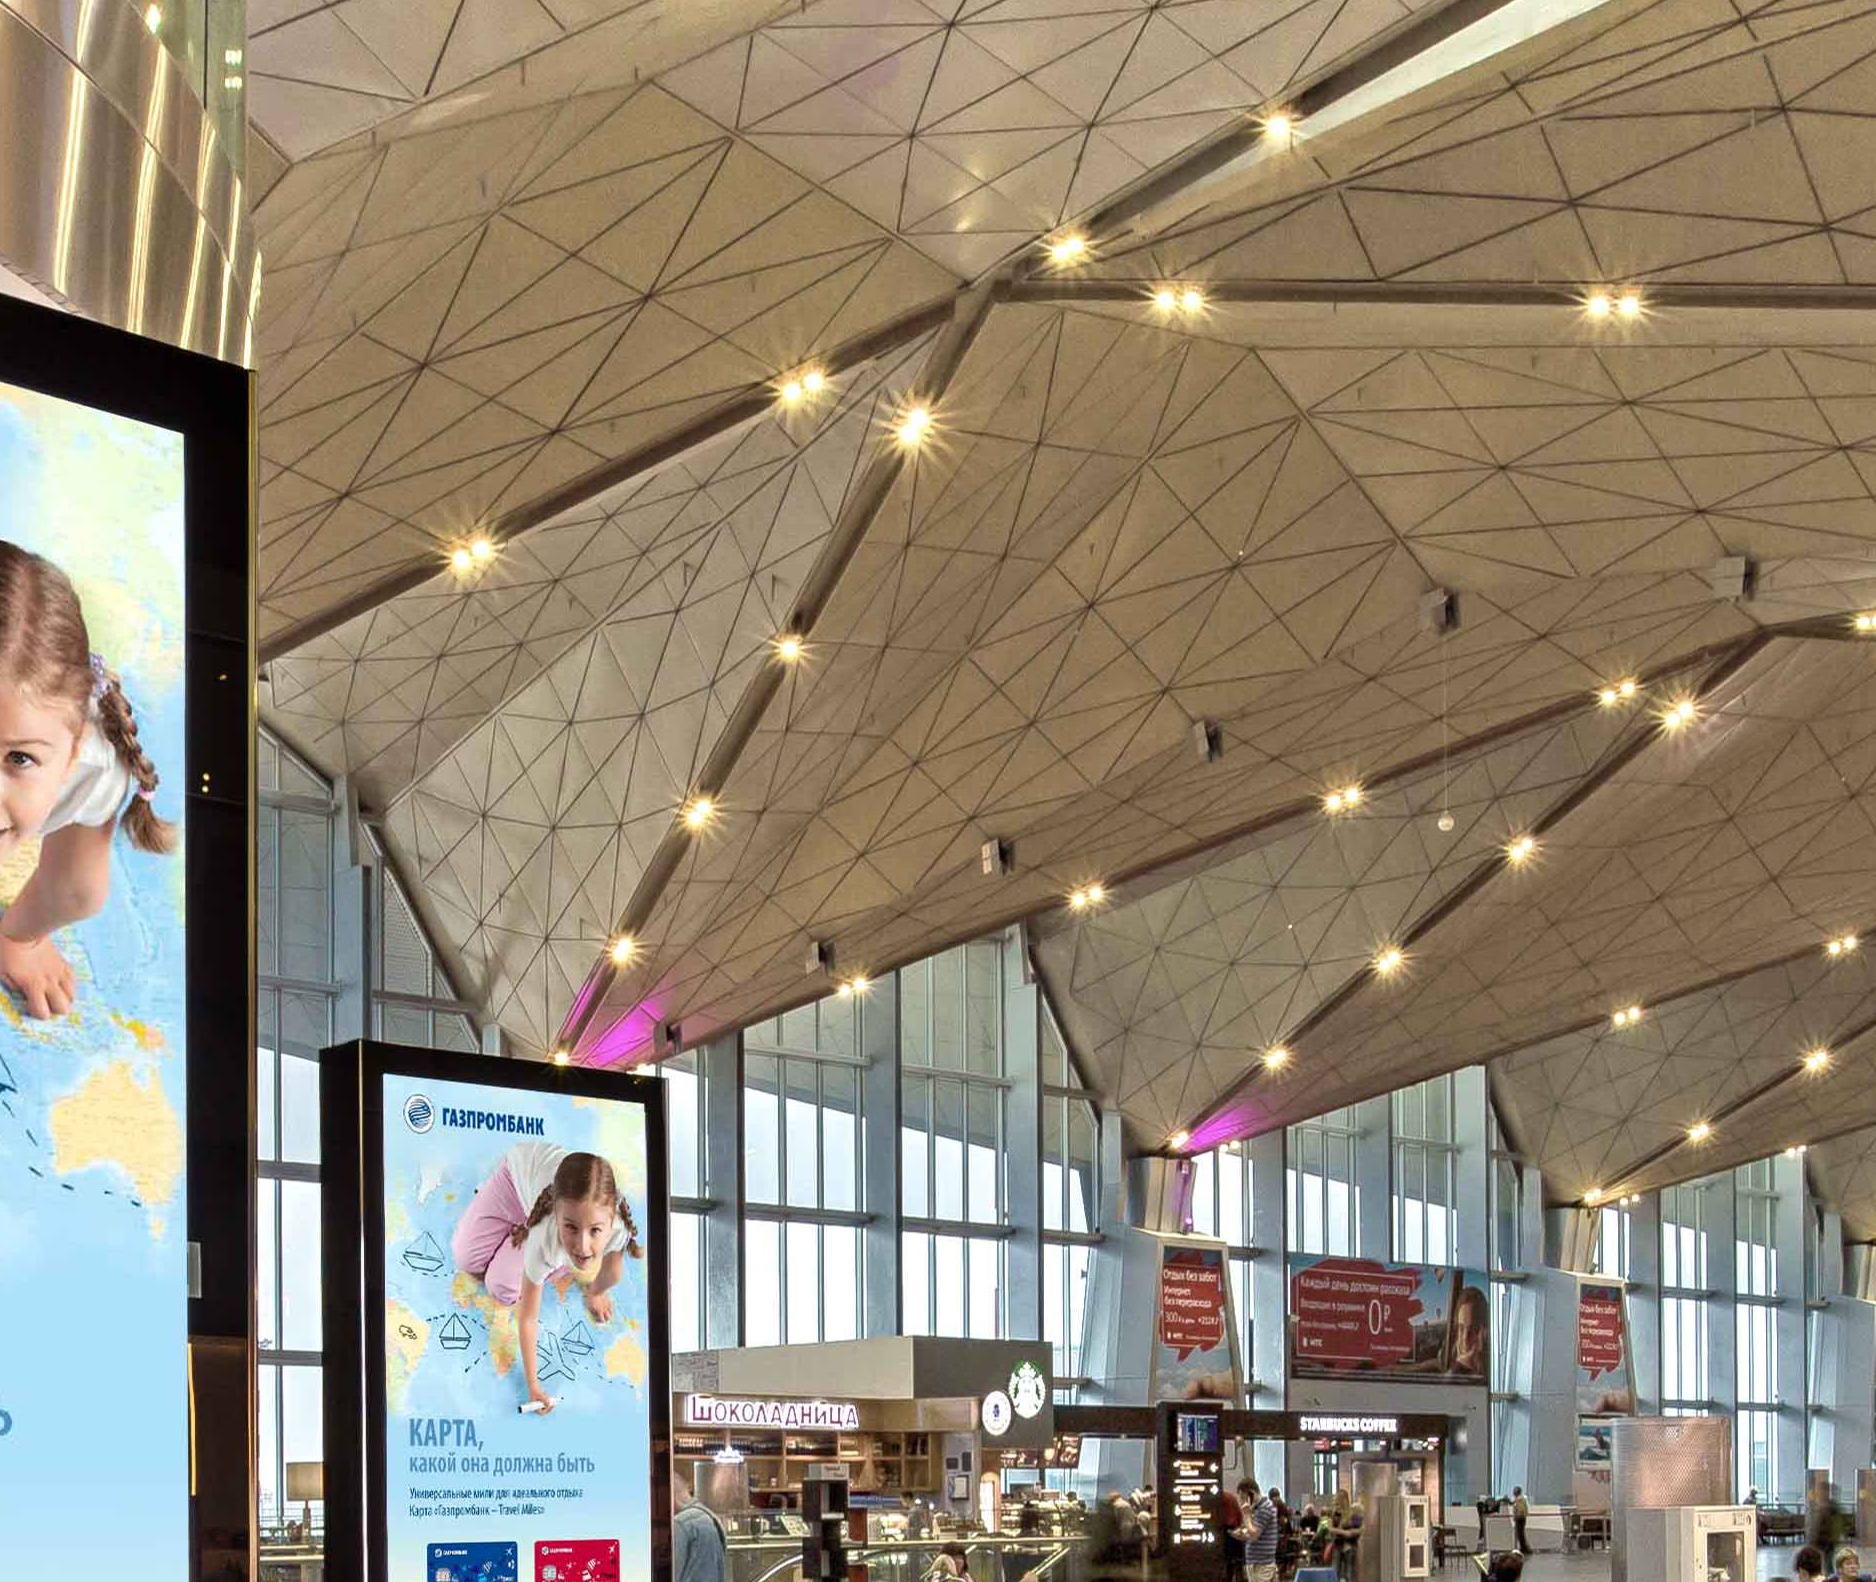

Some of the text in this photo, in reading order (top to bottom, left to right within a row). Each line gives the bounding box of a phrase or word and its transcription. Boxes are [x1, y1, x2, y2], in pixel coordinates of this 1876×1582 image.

[442, 1108, 545, 1136] ГАЗПРОМБАНК
[1369, 1299, 1382, 1335] 0
[409, 1418, 484, 1450] КАРТА,
[1300, 1416, 1397, 1432] STARBUCKS COFFEE
[409, 1453, 595, 1476] какой она должна быть
[409, 1487, 472, 1500] Универсальные
[409, 1504, 432, 1518] Карта
